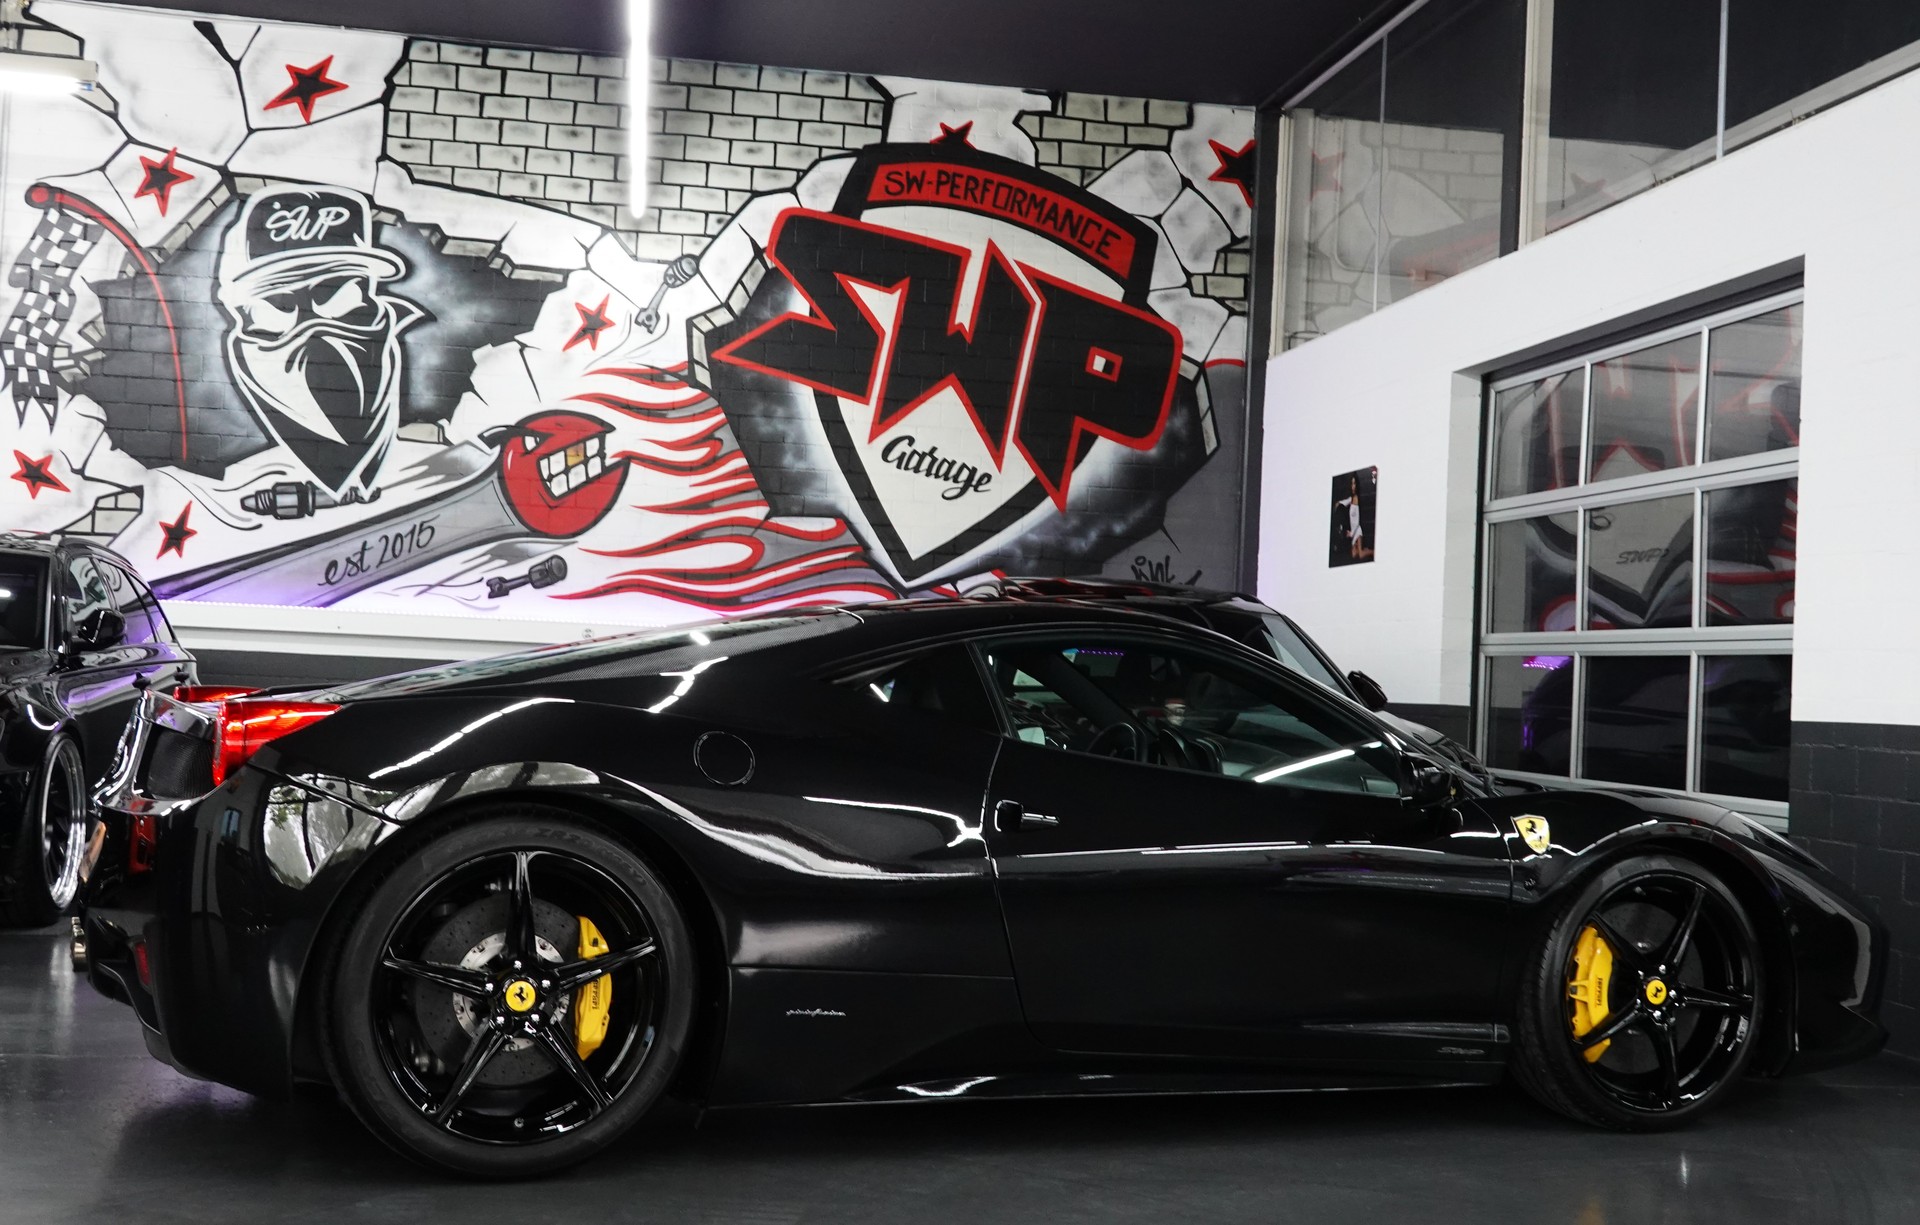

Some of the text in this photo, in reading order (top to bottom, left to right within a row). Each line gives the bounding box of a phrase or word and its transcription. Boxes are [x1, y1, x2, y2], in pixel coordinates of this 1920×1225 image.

[265, 202, 351, 242] SWP
[884, 168, 1122, 261] SW-PERFORMANCE
[711, 207, 1184, 514] SWP
[881, 435, 993, 501] Garage
[317, 514, 440, 586] est 2015
